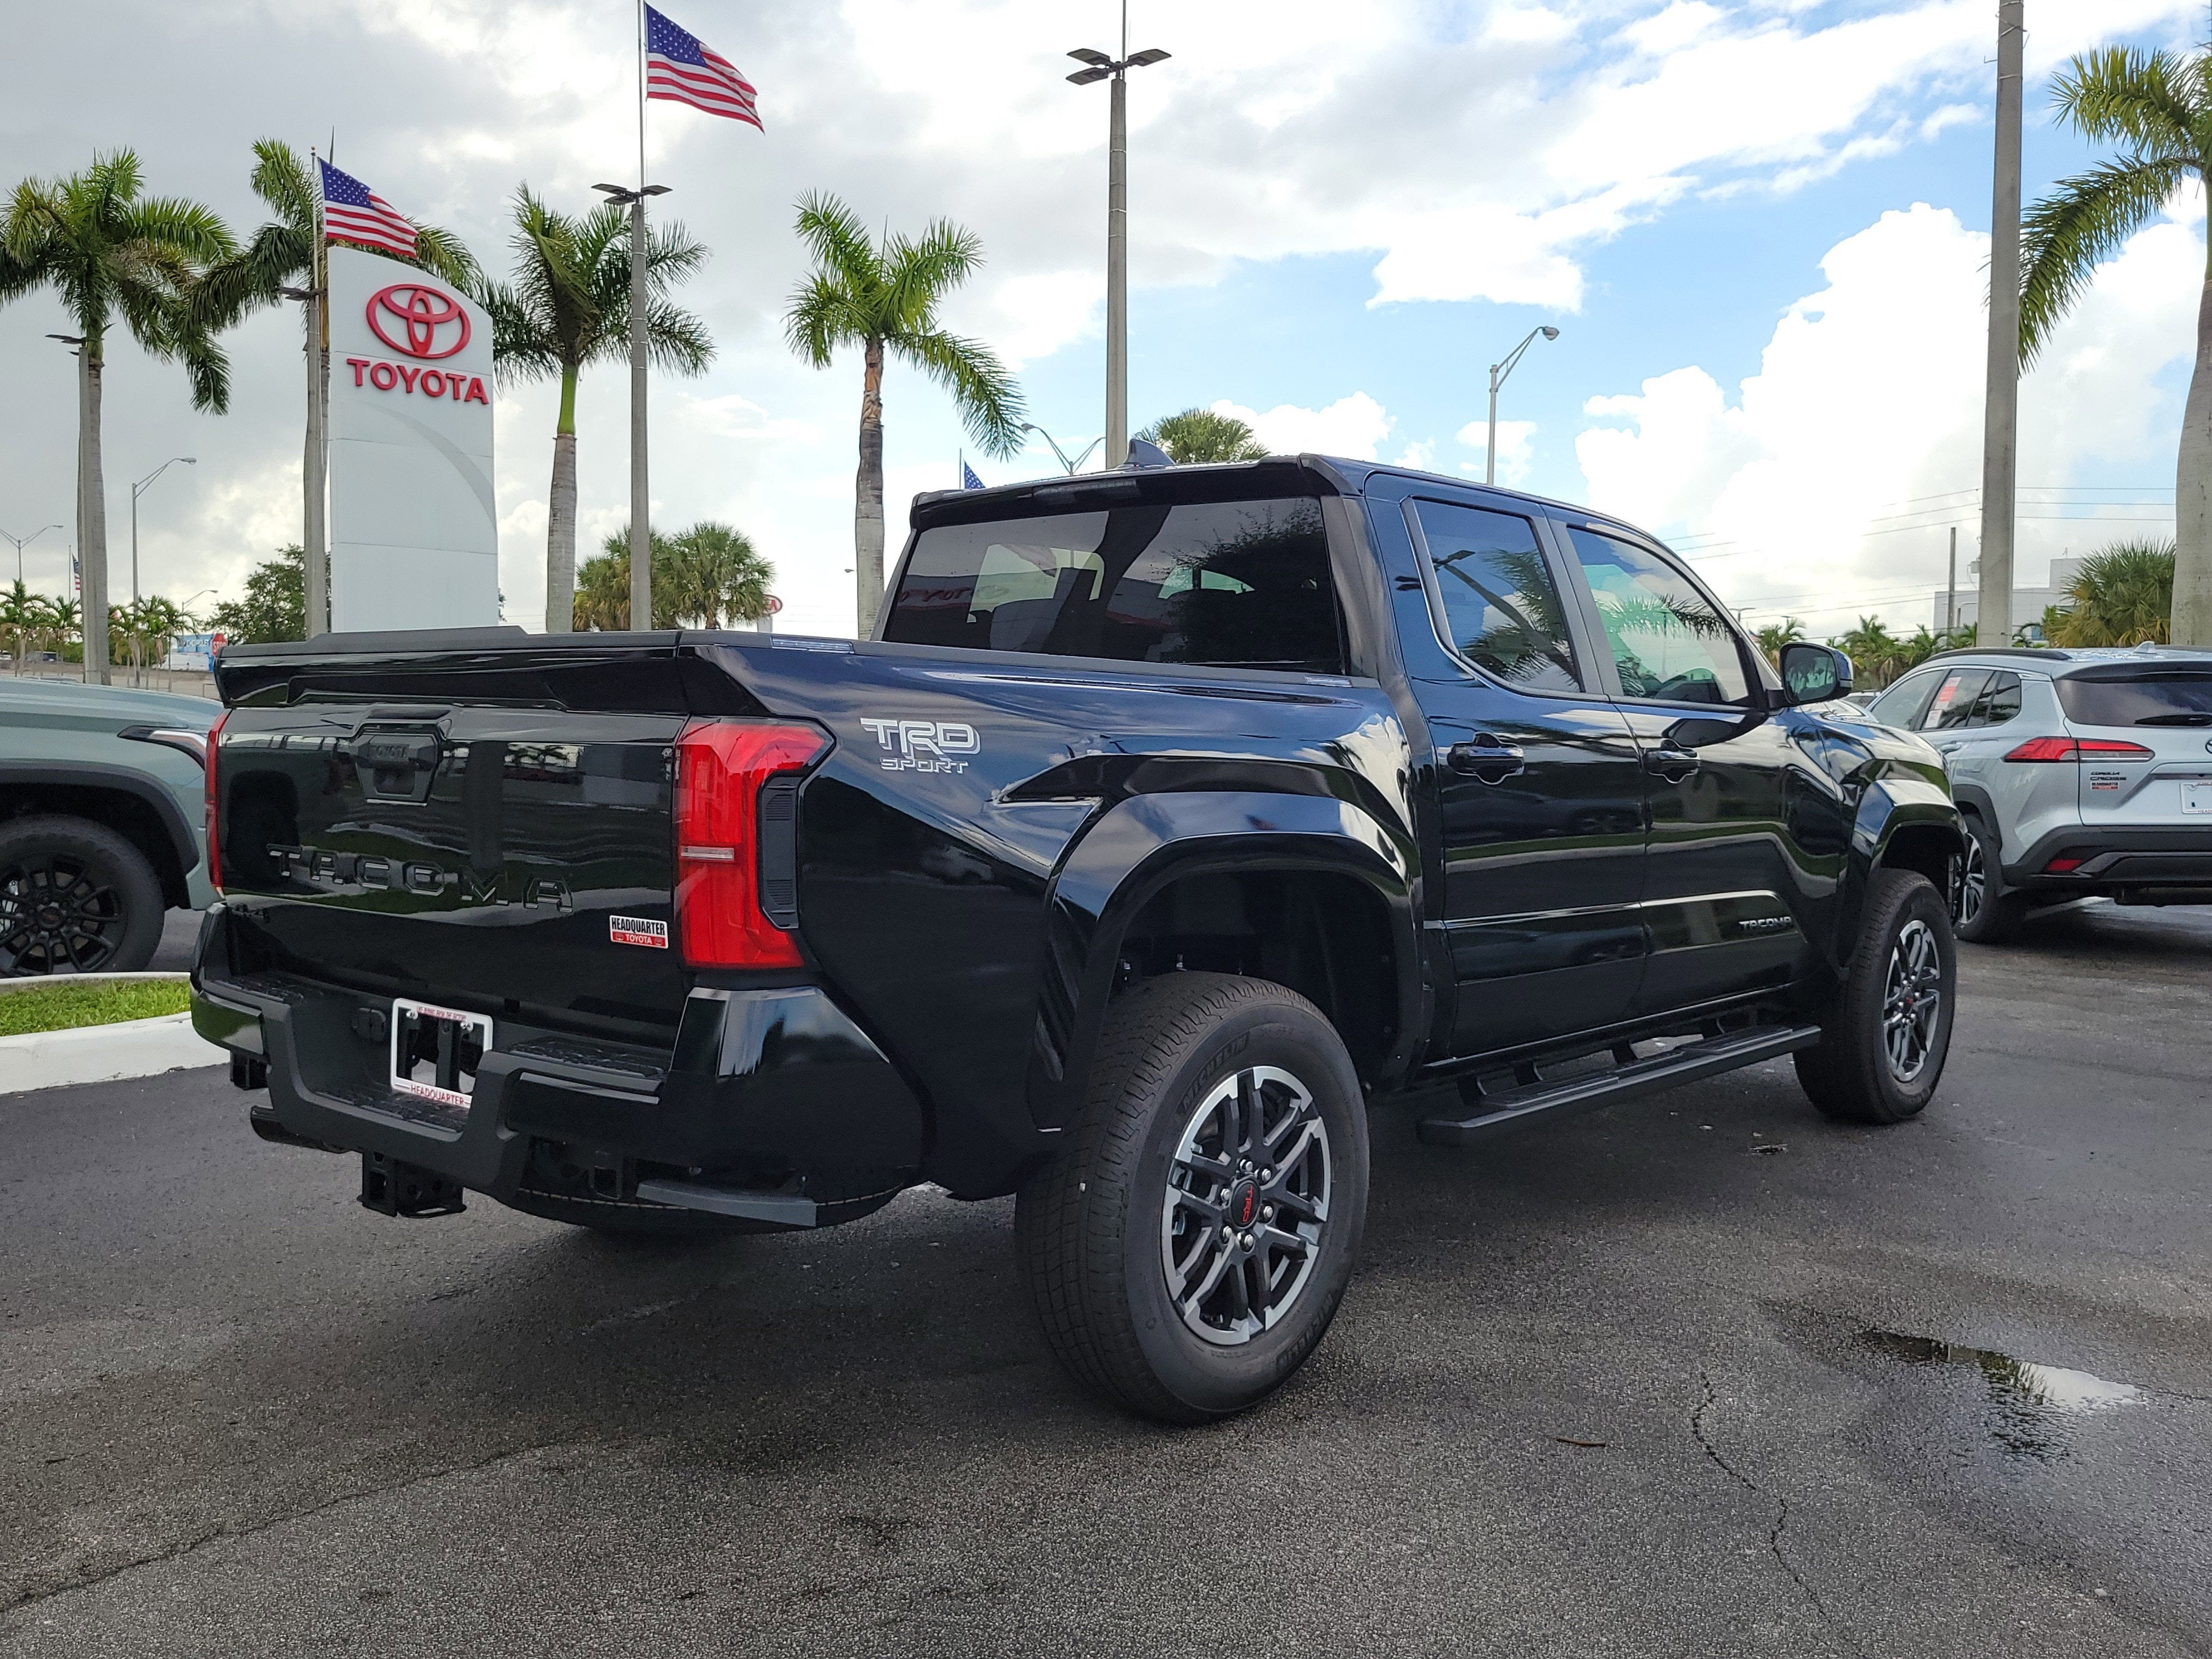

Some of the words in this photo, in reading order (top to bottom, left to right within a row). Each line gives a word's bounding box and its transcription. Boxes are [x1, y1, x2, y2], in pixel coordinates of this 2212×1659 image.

[347, 358, 489, 404] TOYOTA
[860, 718, 980, 761] TRD
[881, 757, 969, 774] SPORT
[267, 844, 573, 913] TACOMA
[611, 917, 665, 935] HEADQUARTER
[625, 934, 652, 944] TOYOTA
[411, 1084, 464, 1104] HEADQUARTER
[1242, 1184, 1253, 1223] TRD
